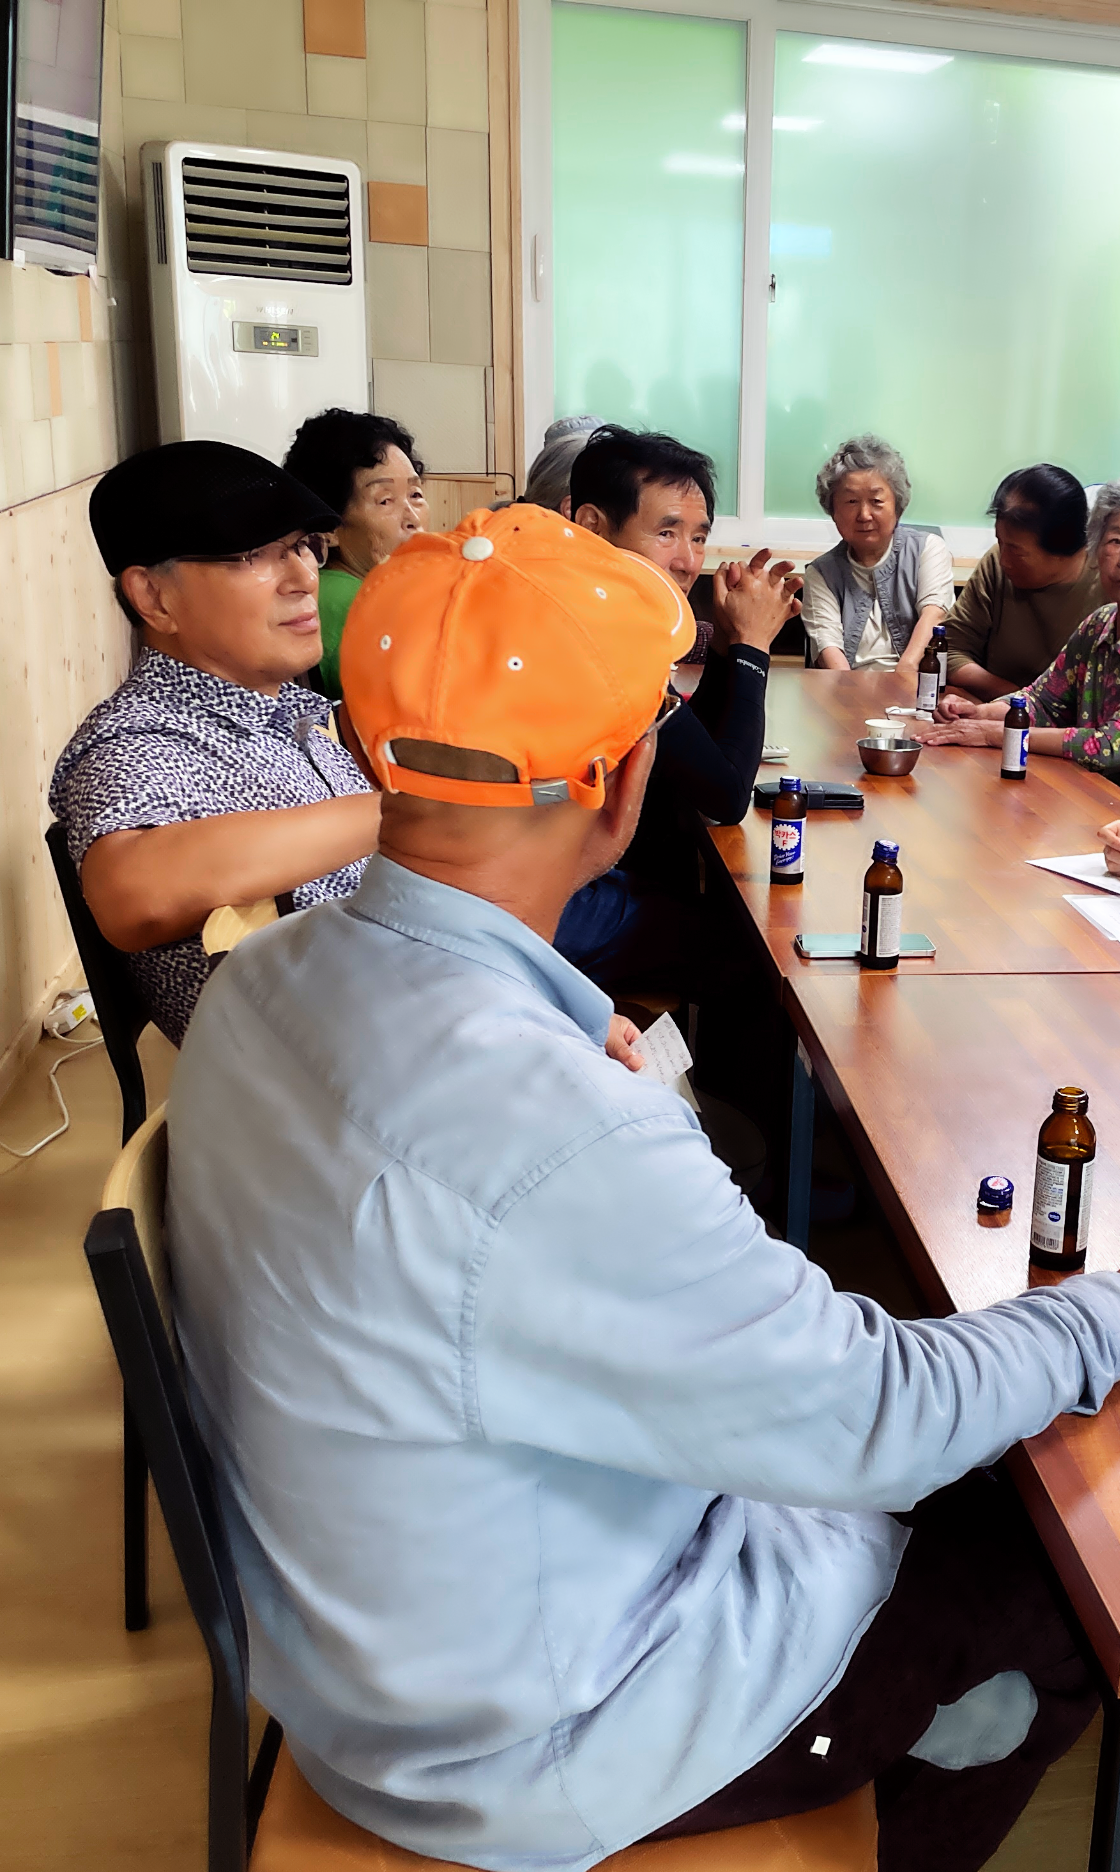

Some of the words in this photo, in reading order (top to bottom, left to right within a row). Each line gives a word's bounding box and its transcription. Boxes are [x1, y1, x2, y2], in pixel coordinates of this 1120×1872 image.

[736, 658, 763, 675] Columbia
[774, 829, 797, 840] 박카스
[782, 839, 789, 847] F
